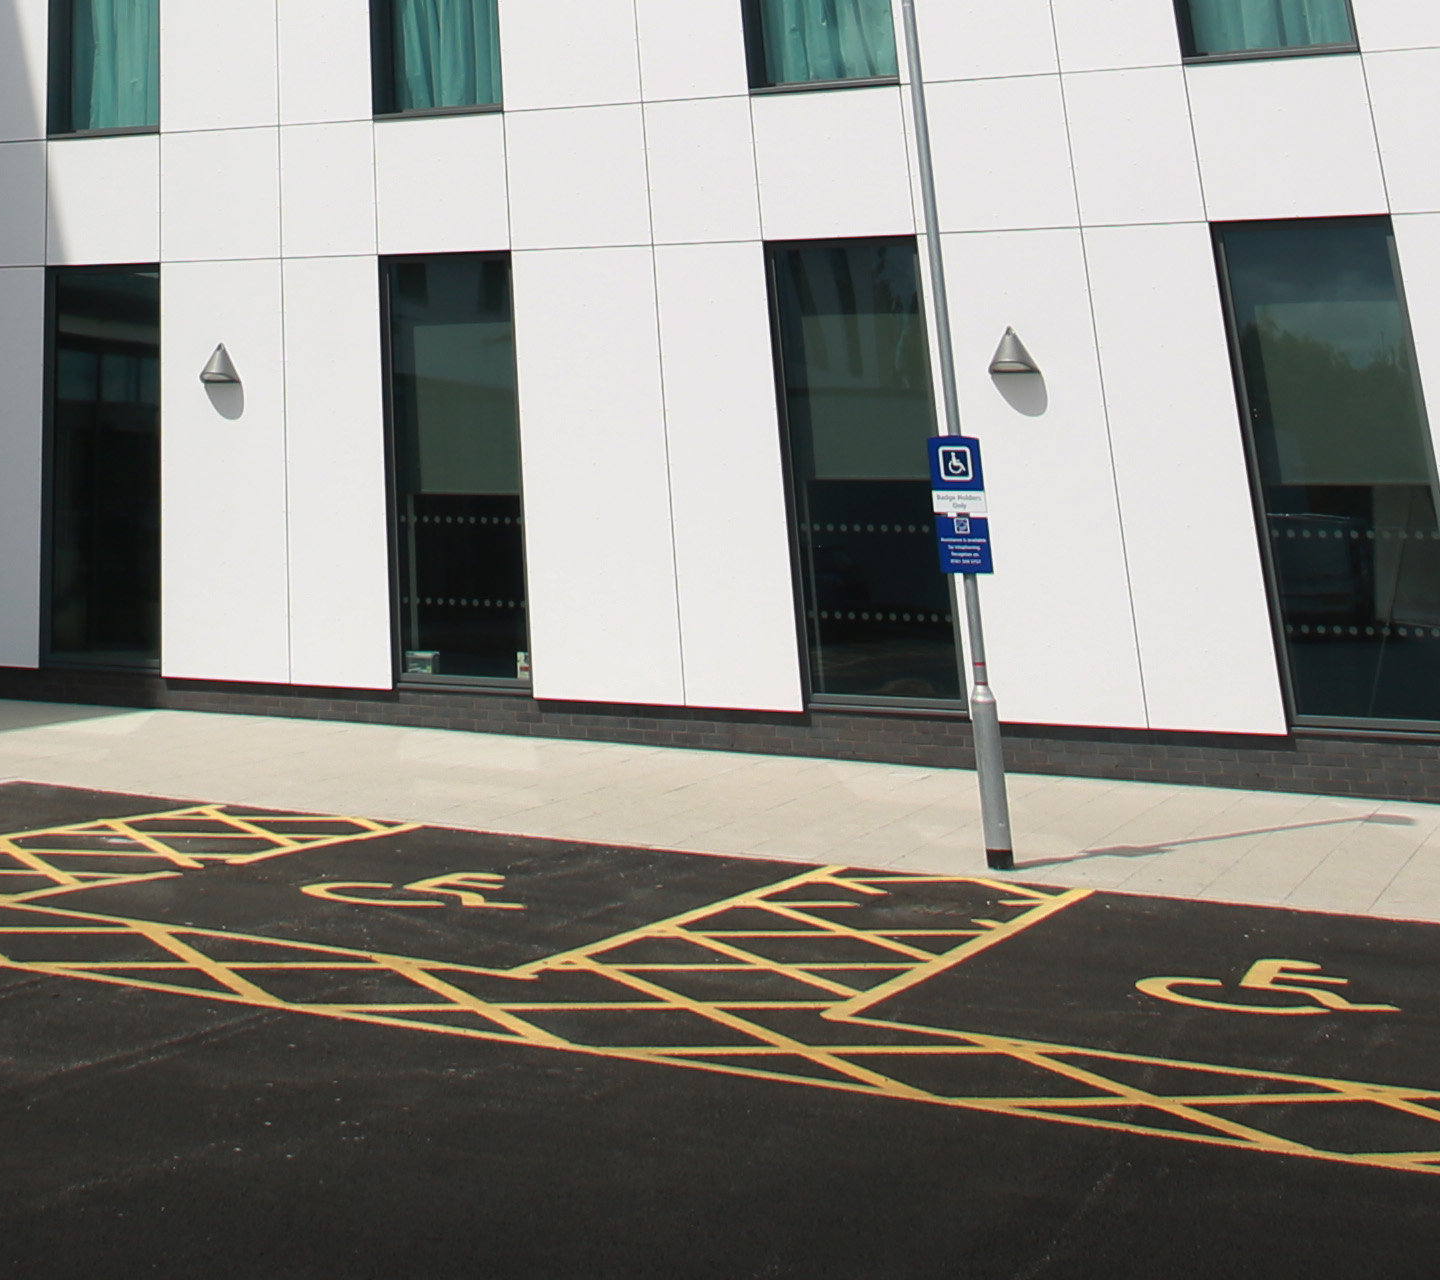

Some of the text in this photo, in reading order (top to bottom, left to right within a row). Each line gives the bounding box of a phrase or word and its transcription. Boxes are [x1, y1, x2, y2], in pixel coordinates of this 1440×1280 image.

[936, 494, 982, 502] Badge Holders
[952, 502, 967, 510] Only
